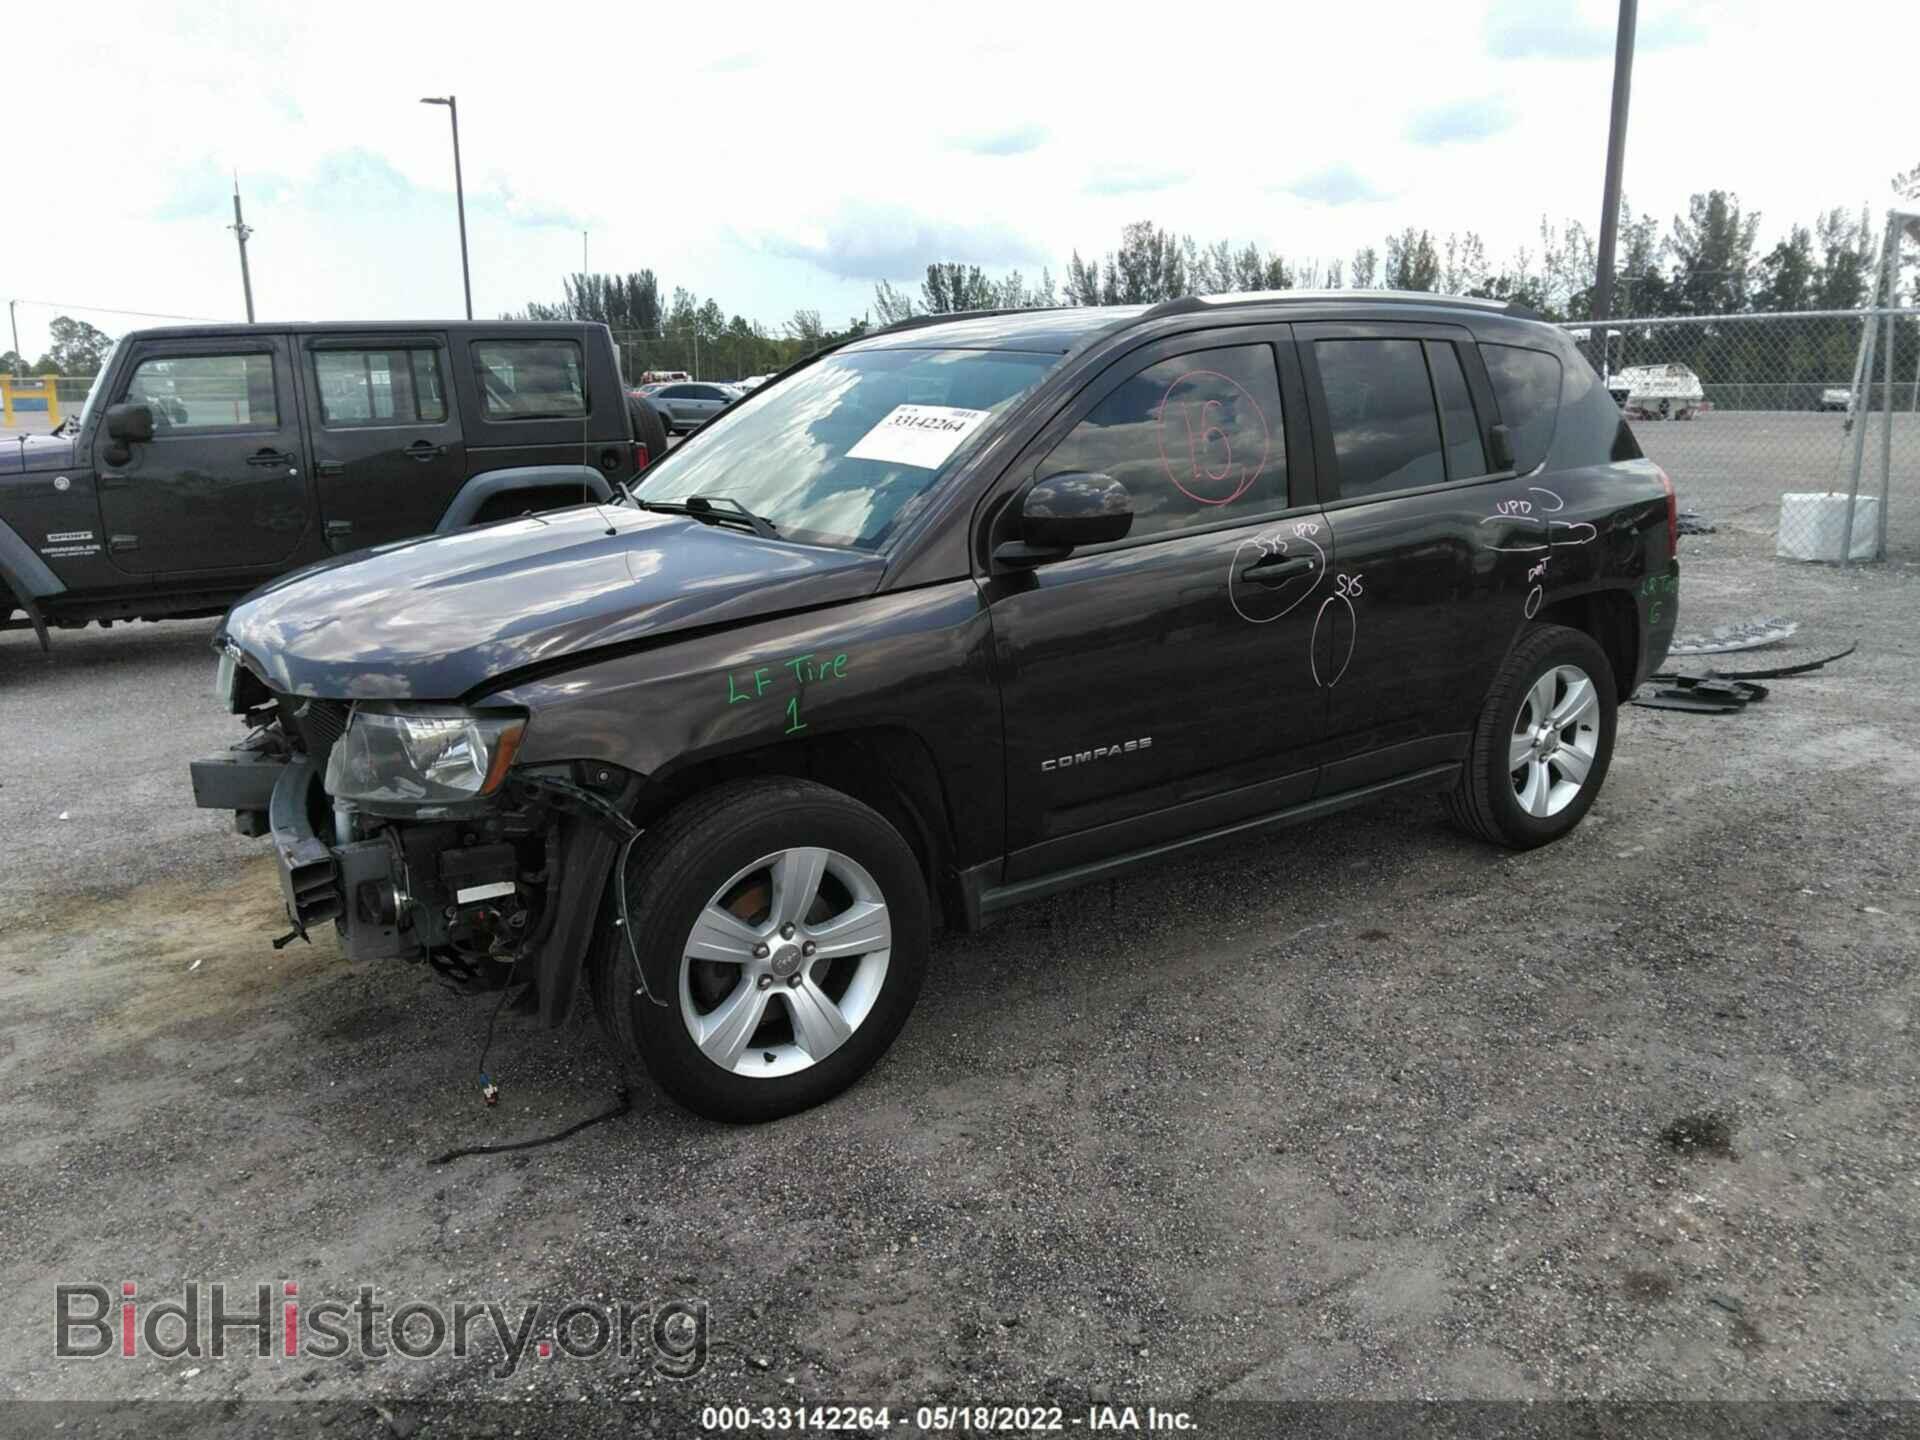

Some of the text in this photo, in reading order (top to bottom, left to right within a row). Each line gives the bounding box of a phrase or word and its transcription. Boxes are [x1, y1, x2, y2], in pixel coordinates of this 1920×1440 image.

[888, 415, 966, 433] 33142264
[1497, 500, 1532, 514] UPD
[729, 654, 847, 704] LF Tire
[785, 698, 808, 734] 1
[1041, 736, 1152, 772] COMPASS
